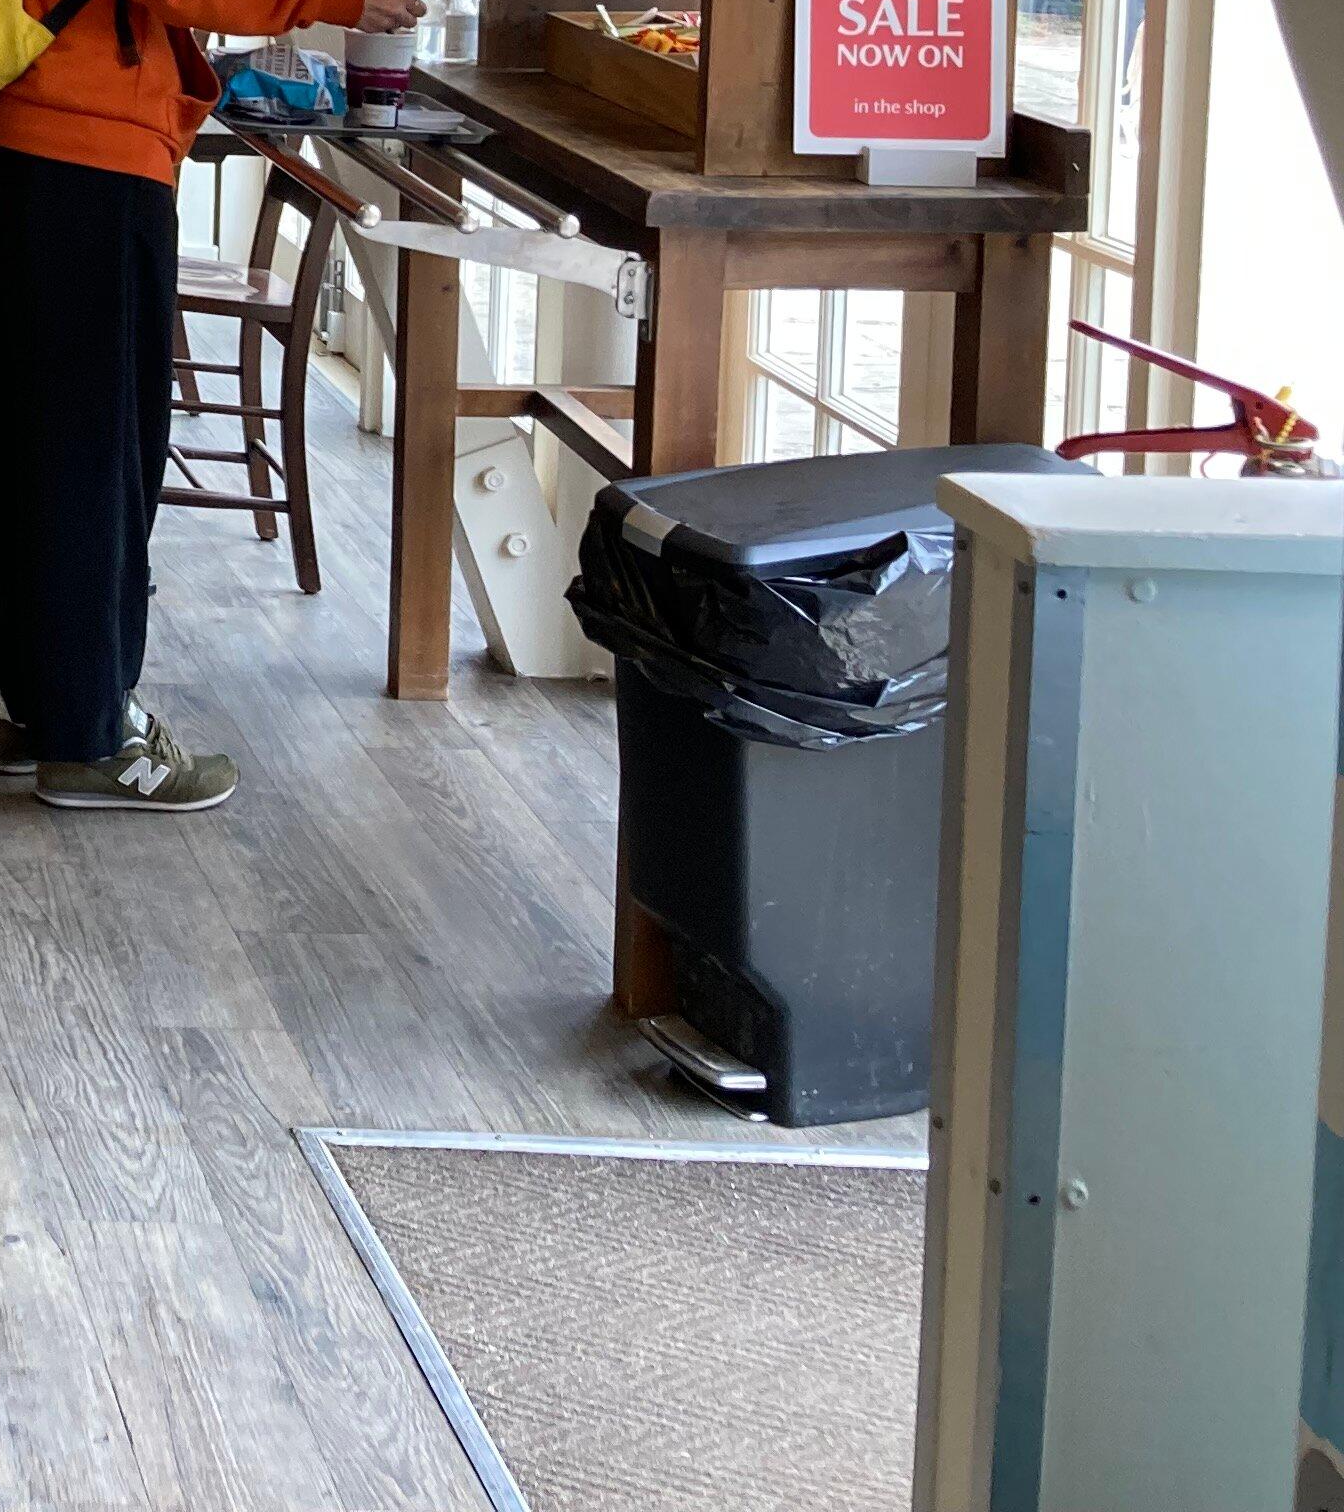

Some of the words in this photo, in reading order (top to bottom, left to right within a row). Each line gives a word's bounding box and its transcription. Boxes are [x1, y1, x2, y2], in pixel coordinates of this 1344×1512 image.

[837, 43, 911, 67] NOW
[918, 45, 964, 68] ON
[854, 98, 869, 114] in
[874, 99, 901, 115] the
[904, 99, 946, 118] shop
